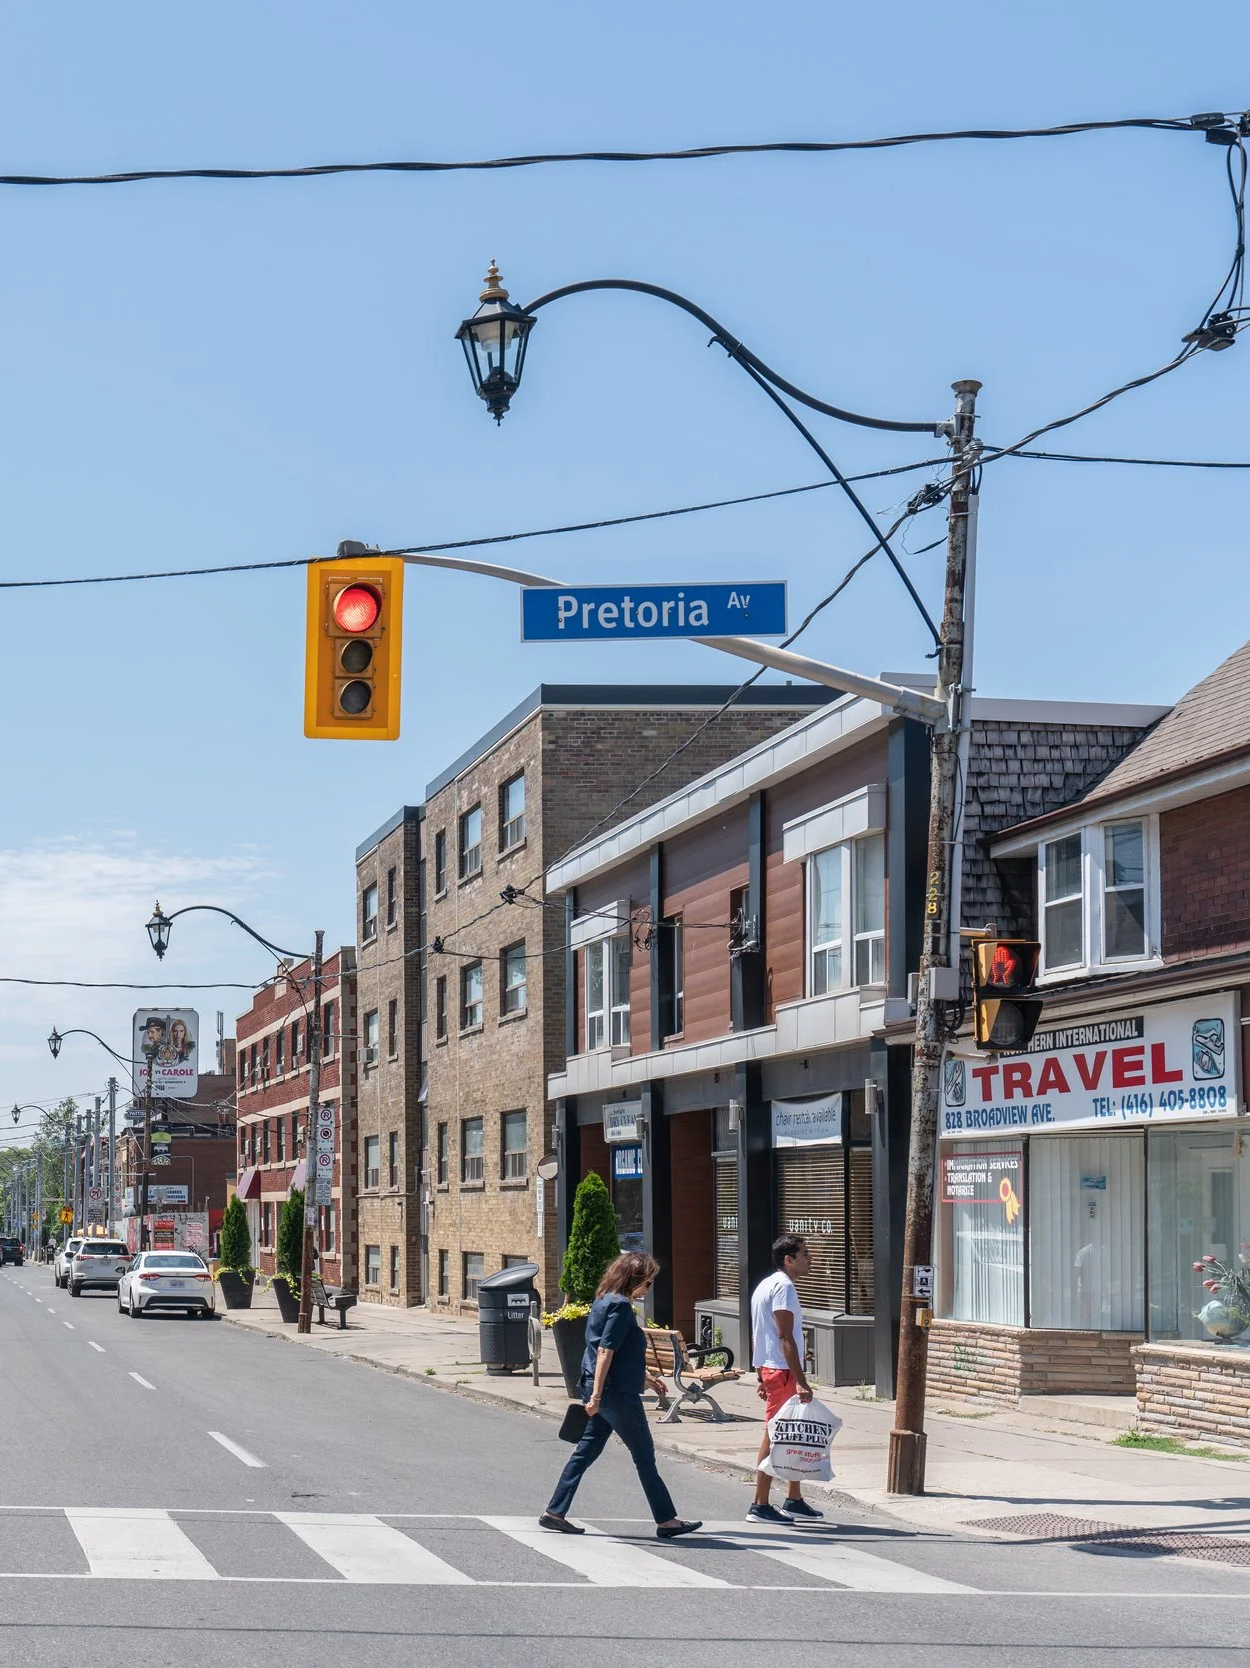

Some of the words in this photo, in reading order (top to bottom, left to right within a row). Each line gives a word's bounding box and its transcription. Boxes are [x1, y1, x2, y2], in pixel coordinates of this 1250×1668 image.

[558, 592, 710, 630] Pretoria
[727, 591, 751, 609] Av
[1055, 1019, 1138, 1048] INTERNATIONAL
[161, 1068, 194, 1077] CAROLE
[972, 1042, 1183, 1103] TRAVEL
[945, 1111, 963, 1130] 828
[965, 1105, 1028, 1128] BROADVIEW
[1031, 1103, 1056, 1125] AVE.
[1092, 1096, 1116, 1118] TEL:
[1121, 1092, 1154, 1120] (416)
[1158, 1085, 1227, 1112] 405-8808
[776, 1111, 792, 1126] chair
[792, 1109, 812, 1125] rental
[811, 1107, 837, 1123] available
[989, 1157, 1019, 1170] SERVICES
[946, 1171, 987, 1184] TRANSLATION
[946, 1184, 975, 1197] NOTARIZE
[507, 1311, 525, 1320] Litter
[775, 1421, 830, 1437] KITCHEN
[774, 1432, 804, 1441] STUFF
[806, 1434, 829, 1446] PLUS
